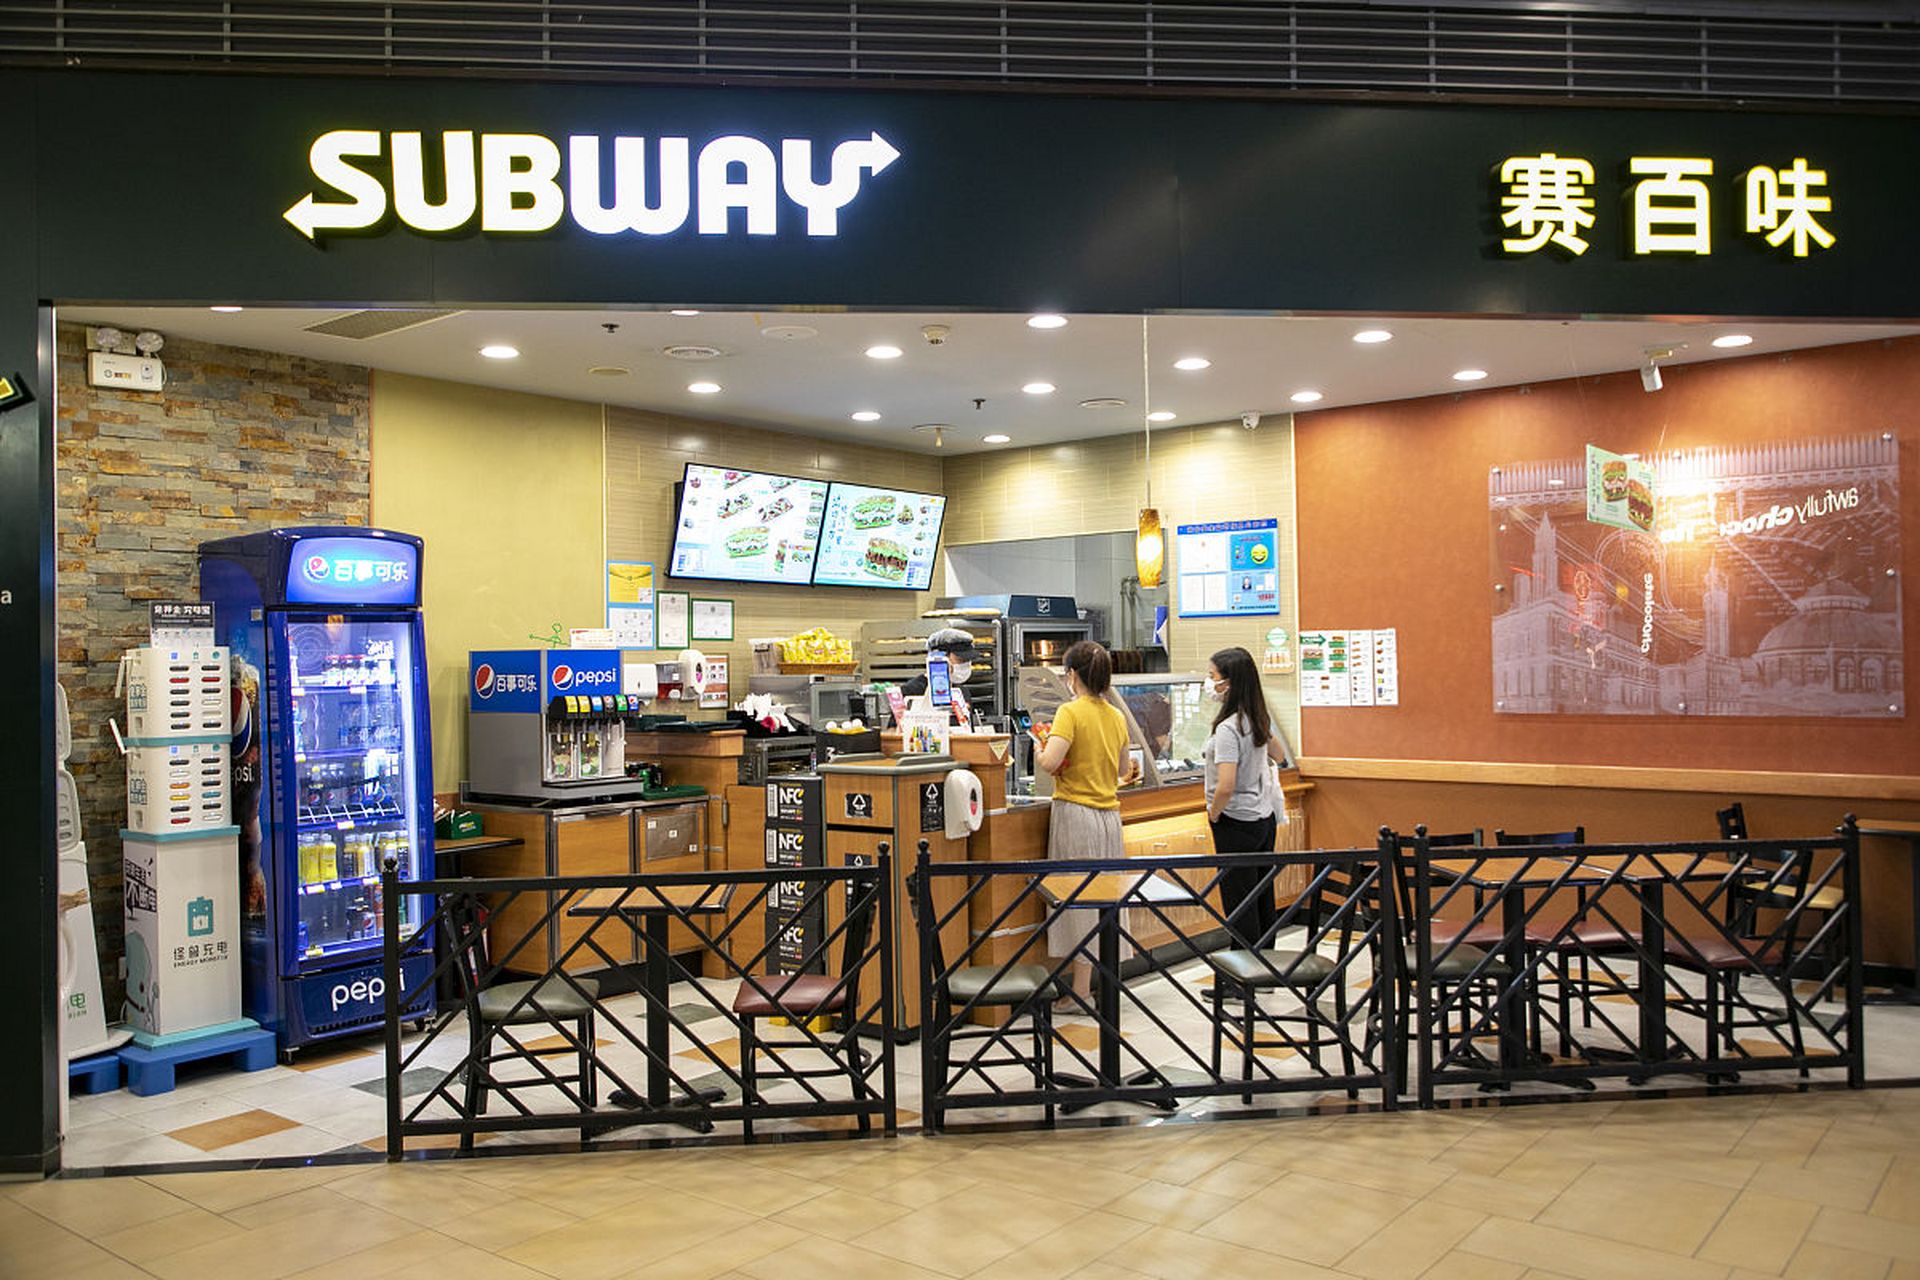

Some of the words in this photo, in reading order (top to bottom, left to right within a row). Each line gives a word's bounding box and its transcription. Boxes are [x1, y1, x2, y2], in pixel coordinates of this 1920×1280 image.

[282, 128, 901, 239] SUBWAY
[1500, 153, 1836, 257] 赛百味
[334, 559, 408, 582] 百事可乐
[496, 673, 537, 692] 百事可乐
[575, 667, 616, 686] pepsi
[779, 787, 804, 805] NFC
[778, 832, 803, 851] NFC
[780, 880, 805, 897] NFC
[331, 967, 406, 1012] pepi
